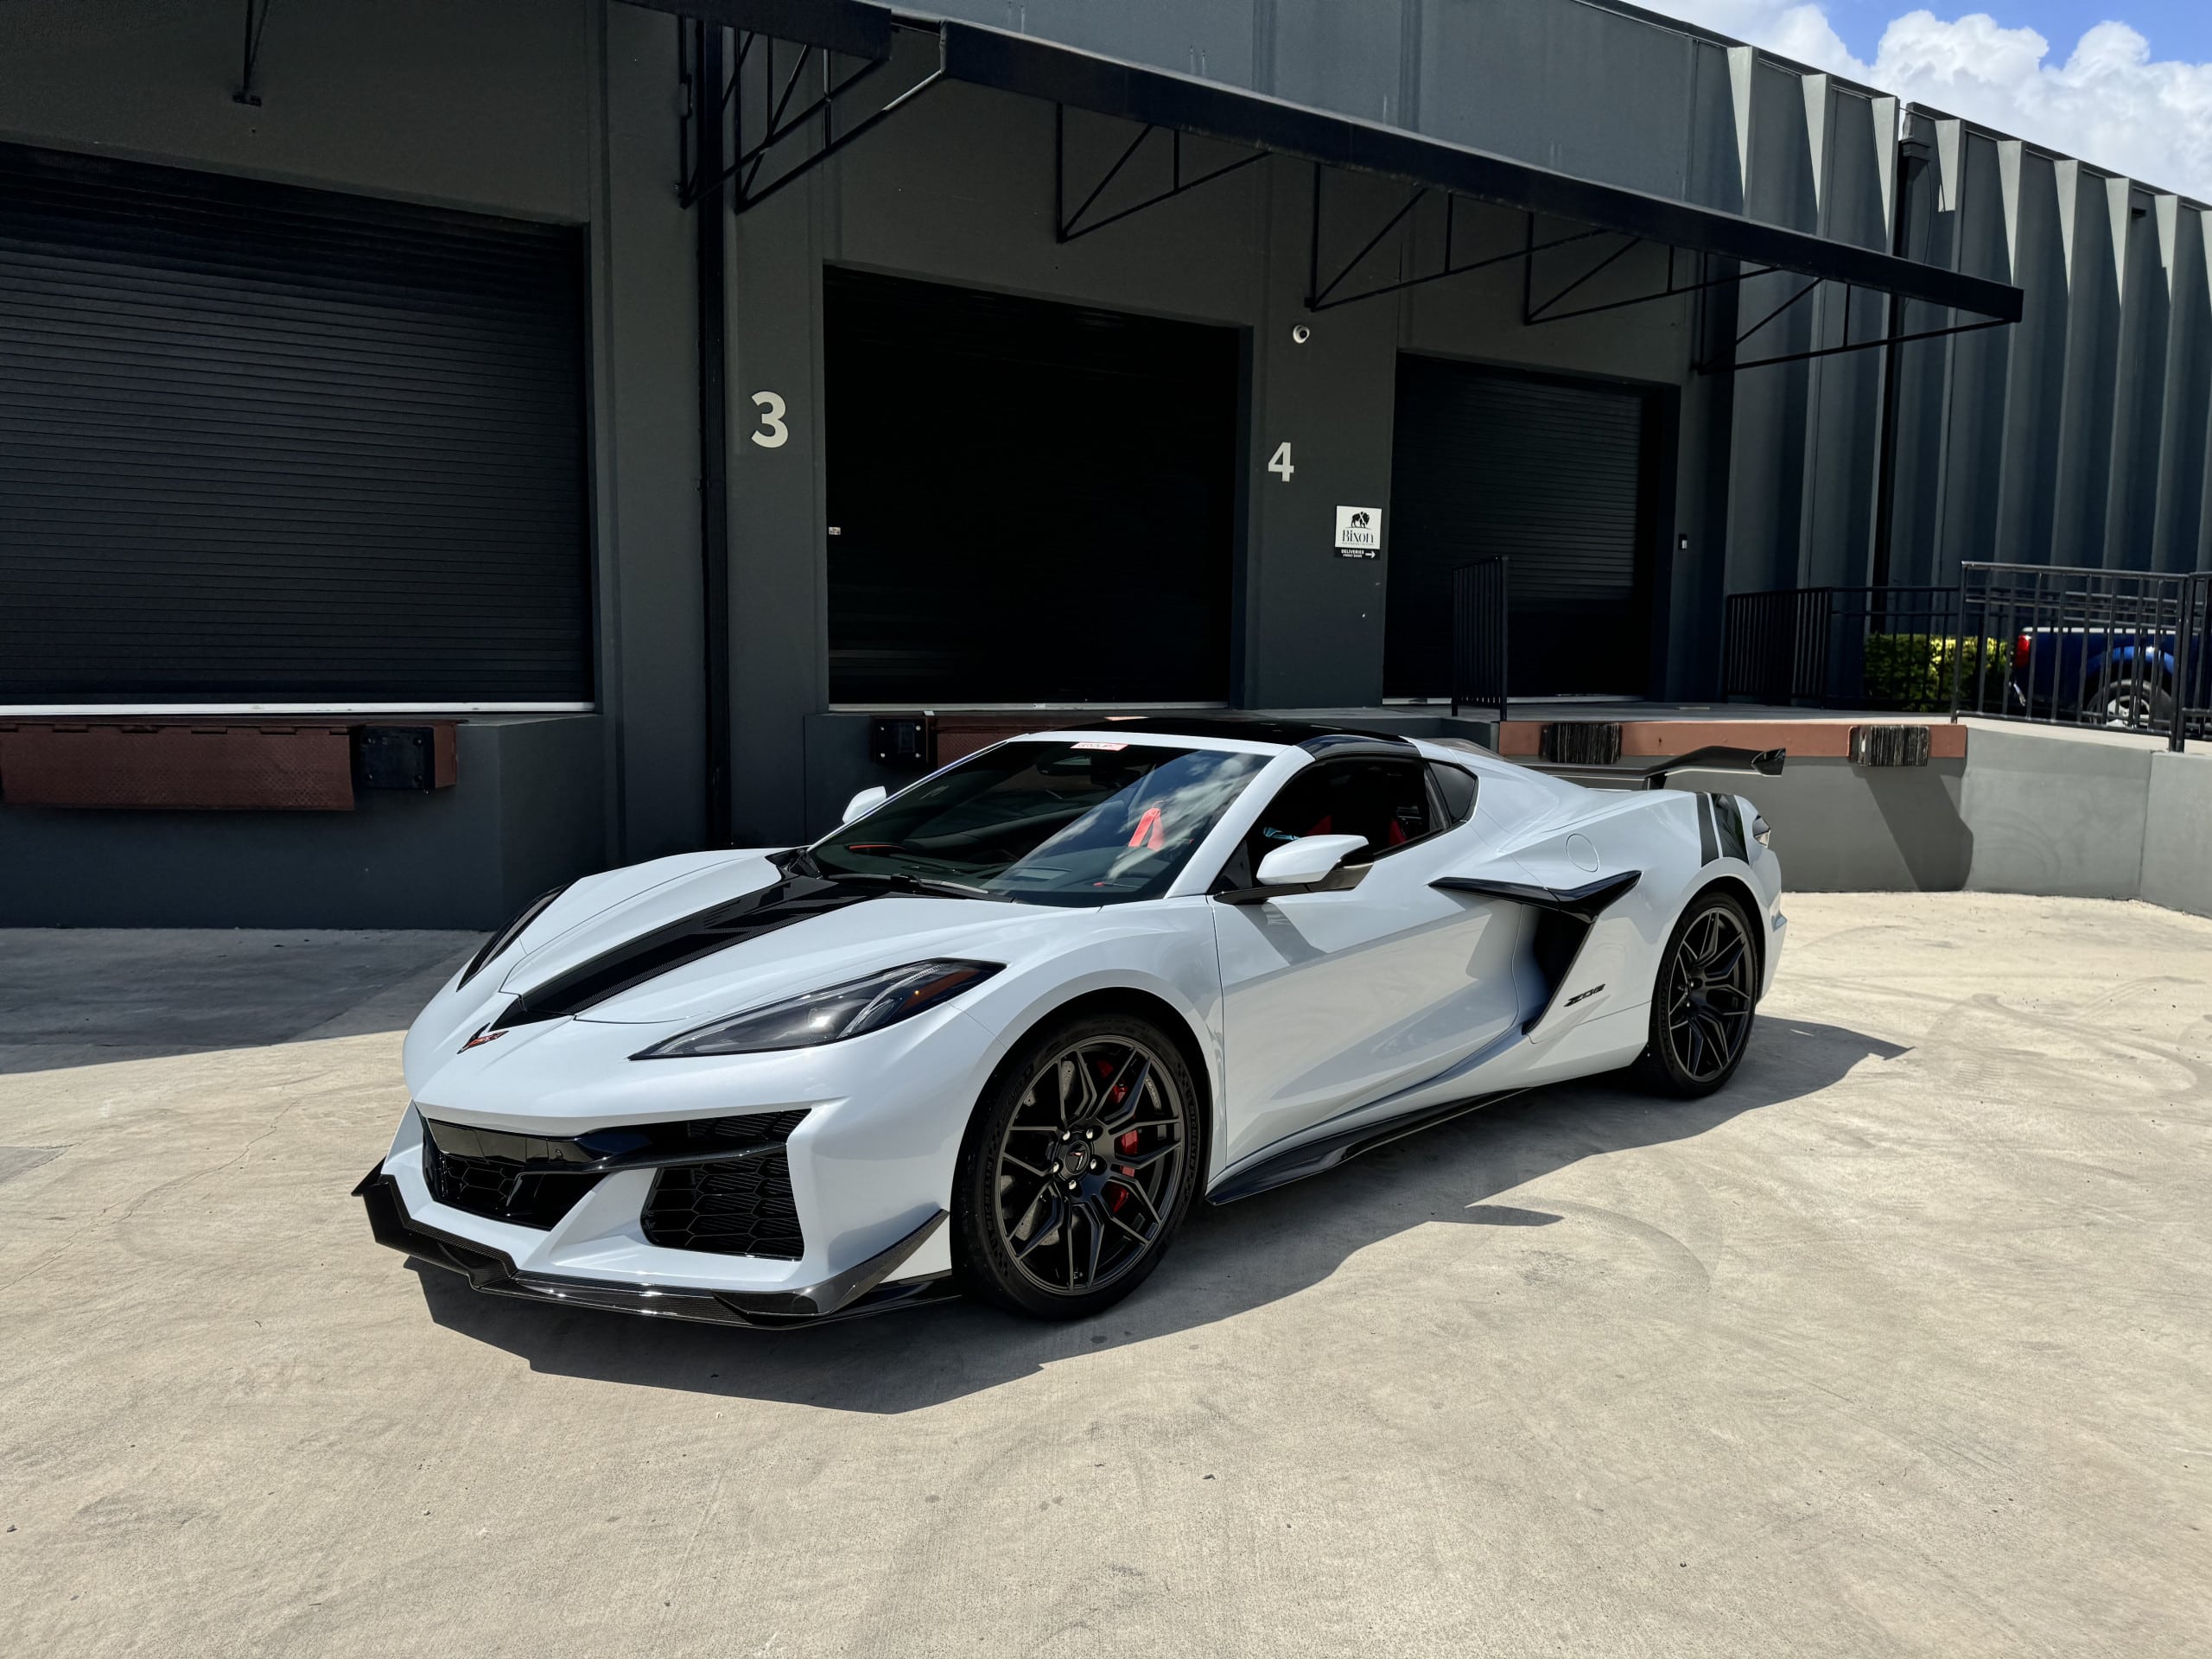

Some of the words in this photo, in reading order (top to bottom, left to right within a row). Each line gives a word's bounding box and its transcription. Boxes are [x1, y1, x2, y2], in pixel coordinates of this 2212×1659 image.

[751, 391, 789, 448] 3
[1268, 442, 1294, 482] 4
[1342, 530, 1374, 543] Bixon
[1563, 983, 1606, 1007] Z06
[1189, 1105, 1198, 1169] MICHELIN
[983, 1160, 995, 1231] MICHELIN
